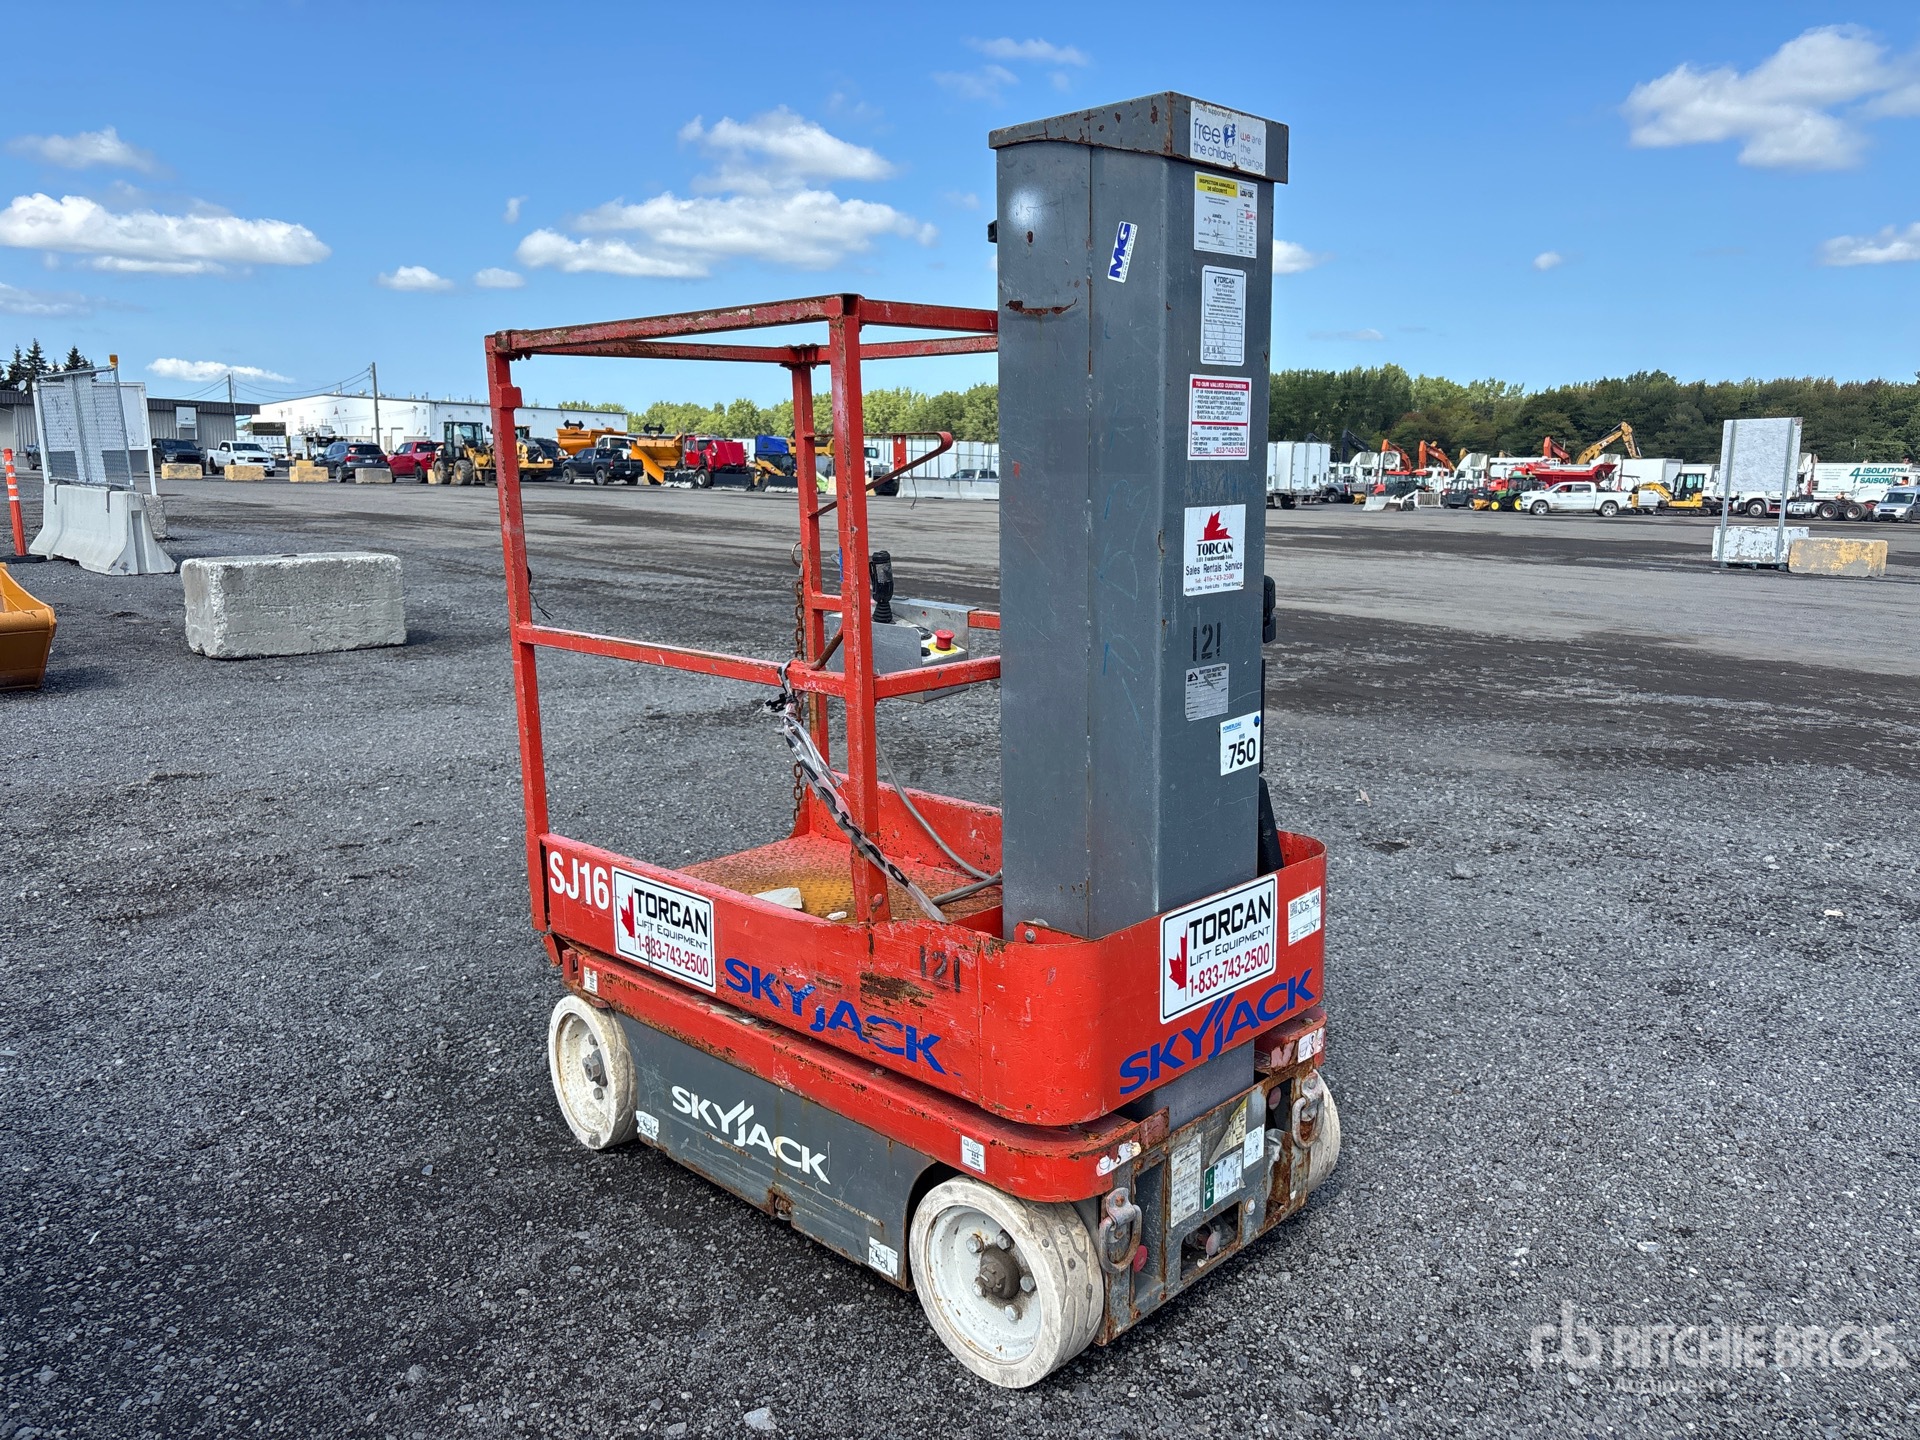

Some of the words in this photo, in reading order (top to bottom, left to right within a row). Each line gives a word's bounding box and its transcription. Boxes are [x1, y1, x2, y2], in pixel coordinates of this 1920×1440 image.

[1193, 118, 1221, 144] free
[1240, 132, 1251, 143] we
[1251, 136, 1262, 146] are
[1193, 141, 1207, 155] the
[1207, 146, 1237, 163] children
[1240, 143, 1251, 155] the
[1240, 156, 1264, 170] change
[1217, 276, 1235, 285] TORCAN
[1849, 467, 1861, 484] 4
[1196, 541, 1234, 556] TORCAN
[1185, 564, 1201, 576] Sales
[1202, 561, 1222, 573] Rentals
[1224, 559, 1243, 571] Service
[1228, 737, 1256, 769] 750
[549, 850, 610, 910] SJ16
[634, 887, 708, 938] TORCAN
[1189, 891, 1272, 950] TORCAN
[636, 916, 653, 931] LIFT
[657, 924, 709, 951] EQUIPMENT
[1189, 949, 1212, 967] LIFT
[1214, 925, 1271, 957] EQUIPMENT
[1189, 942, 1270, 997] 1-833-743-2500
[724, 957, 947, 1076] SKYJACK
[1119, 968, 1315, 1095] SKYJACK
[671, 1085, 831, 1185] SKYJACK
